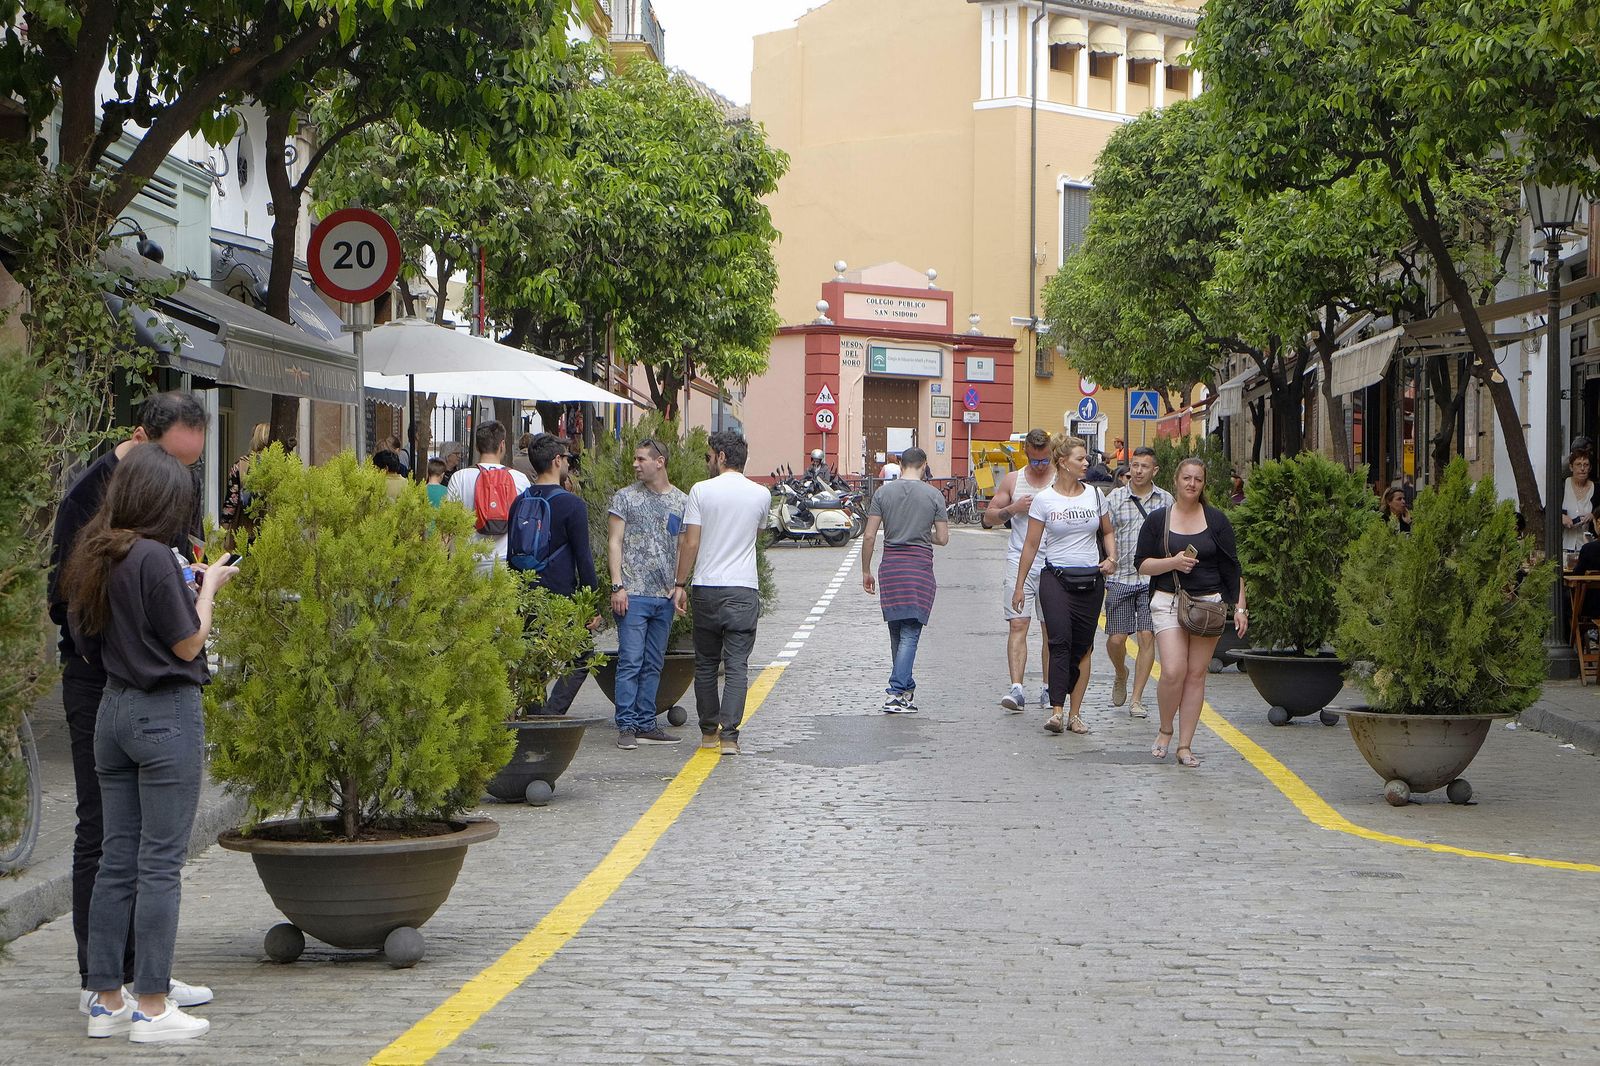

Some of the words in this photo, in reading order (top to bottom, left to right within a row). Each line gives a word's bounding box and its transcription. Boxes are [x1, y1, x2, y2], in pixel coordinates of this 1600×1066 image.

[333, 240, 376, 269] 20
[866, 297, 894, 306] COLEGIO
[892, 310, 918, 318] ISIDORO
[846, 350, 858, 358] DEL
[842, 359, 861, 367] MORO
[818, 414, 832, 423] 30
[1050, 508, 1099, 522] Desmadr
